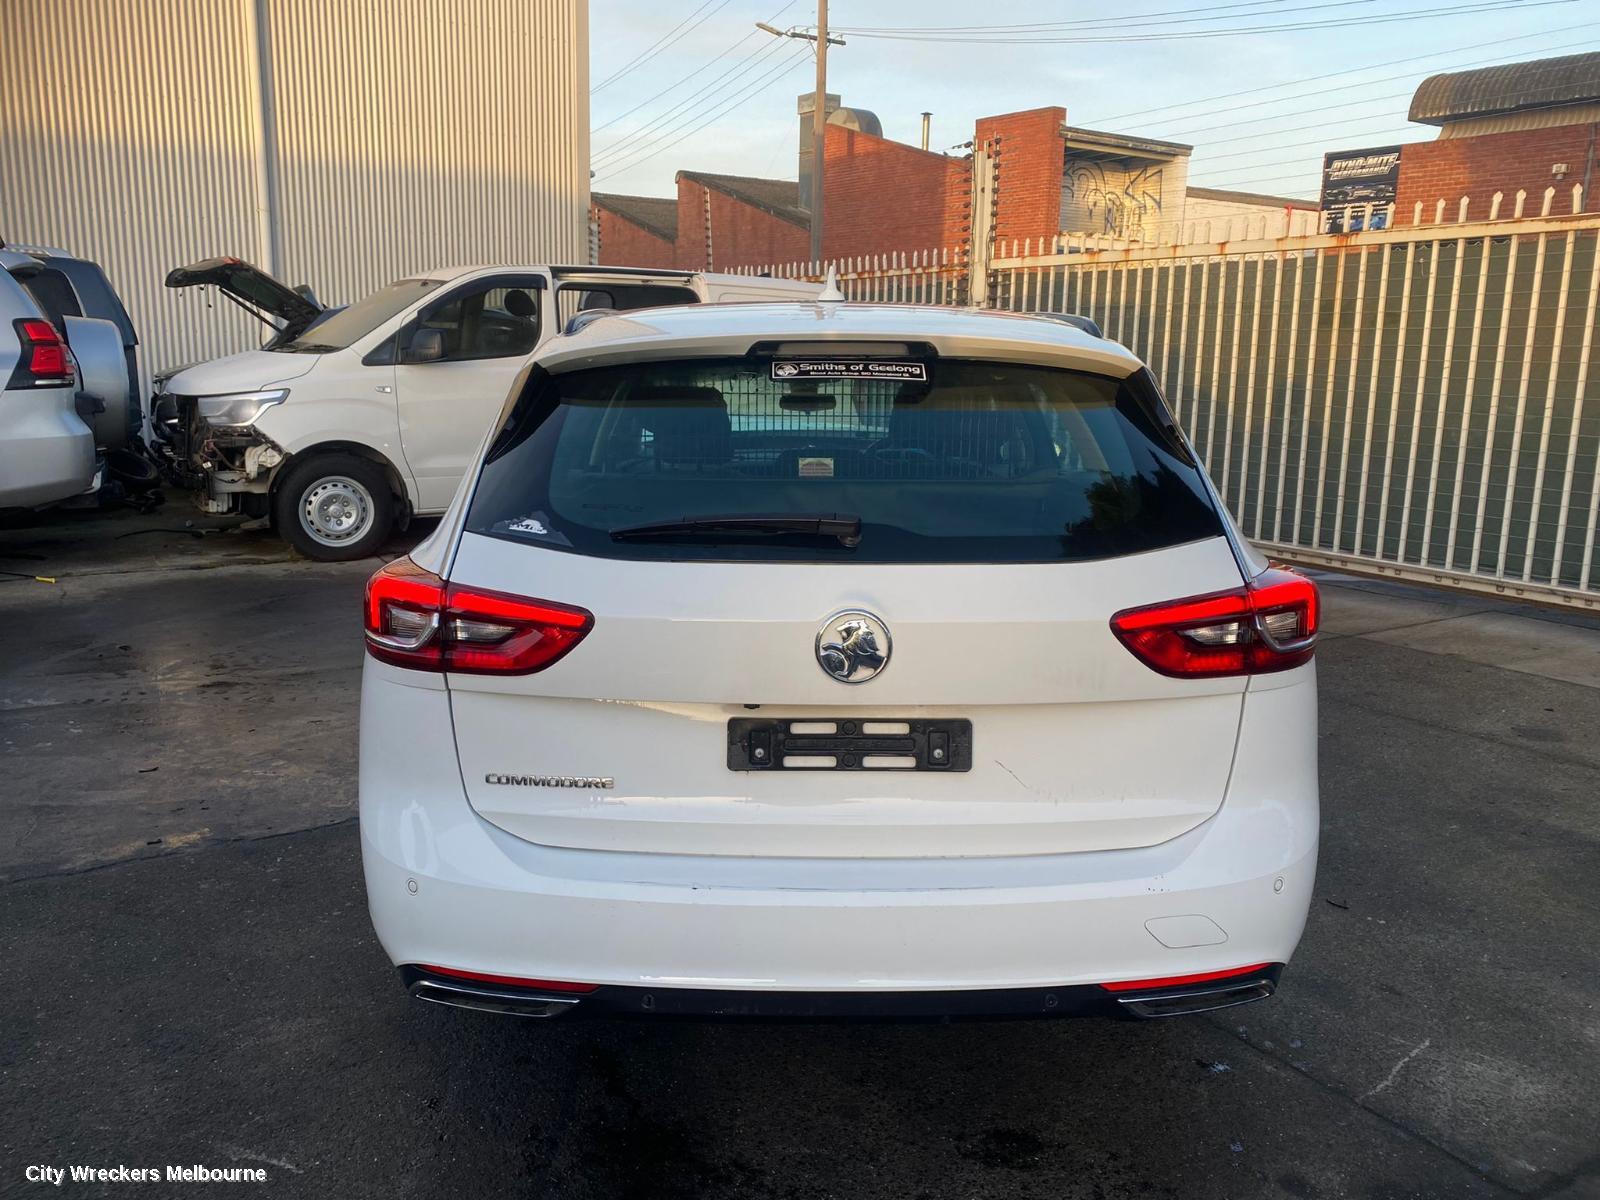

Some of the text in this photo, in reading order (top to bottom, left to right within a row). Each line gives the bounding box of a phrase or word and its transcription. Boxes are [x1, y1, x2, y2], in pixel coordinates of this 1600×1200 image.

[800, 363, 921, 374] Smiths of Geelong
[485, 773, 615, 790] COMMODORE
